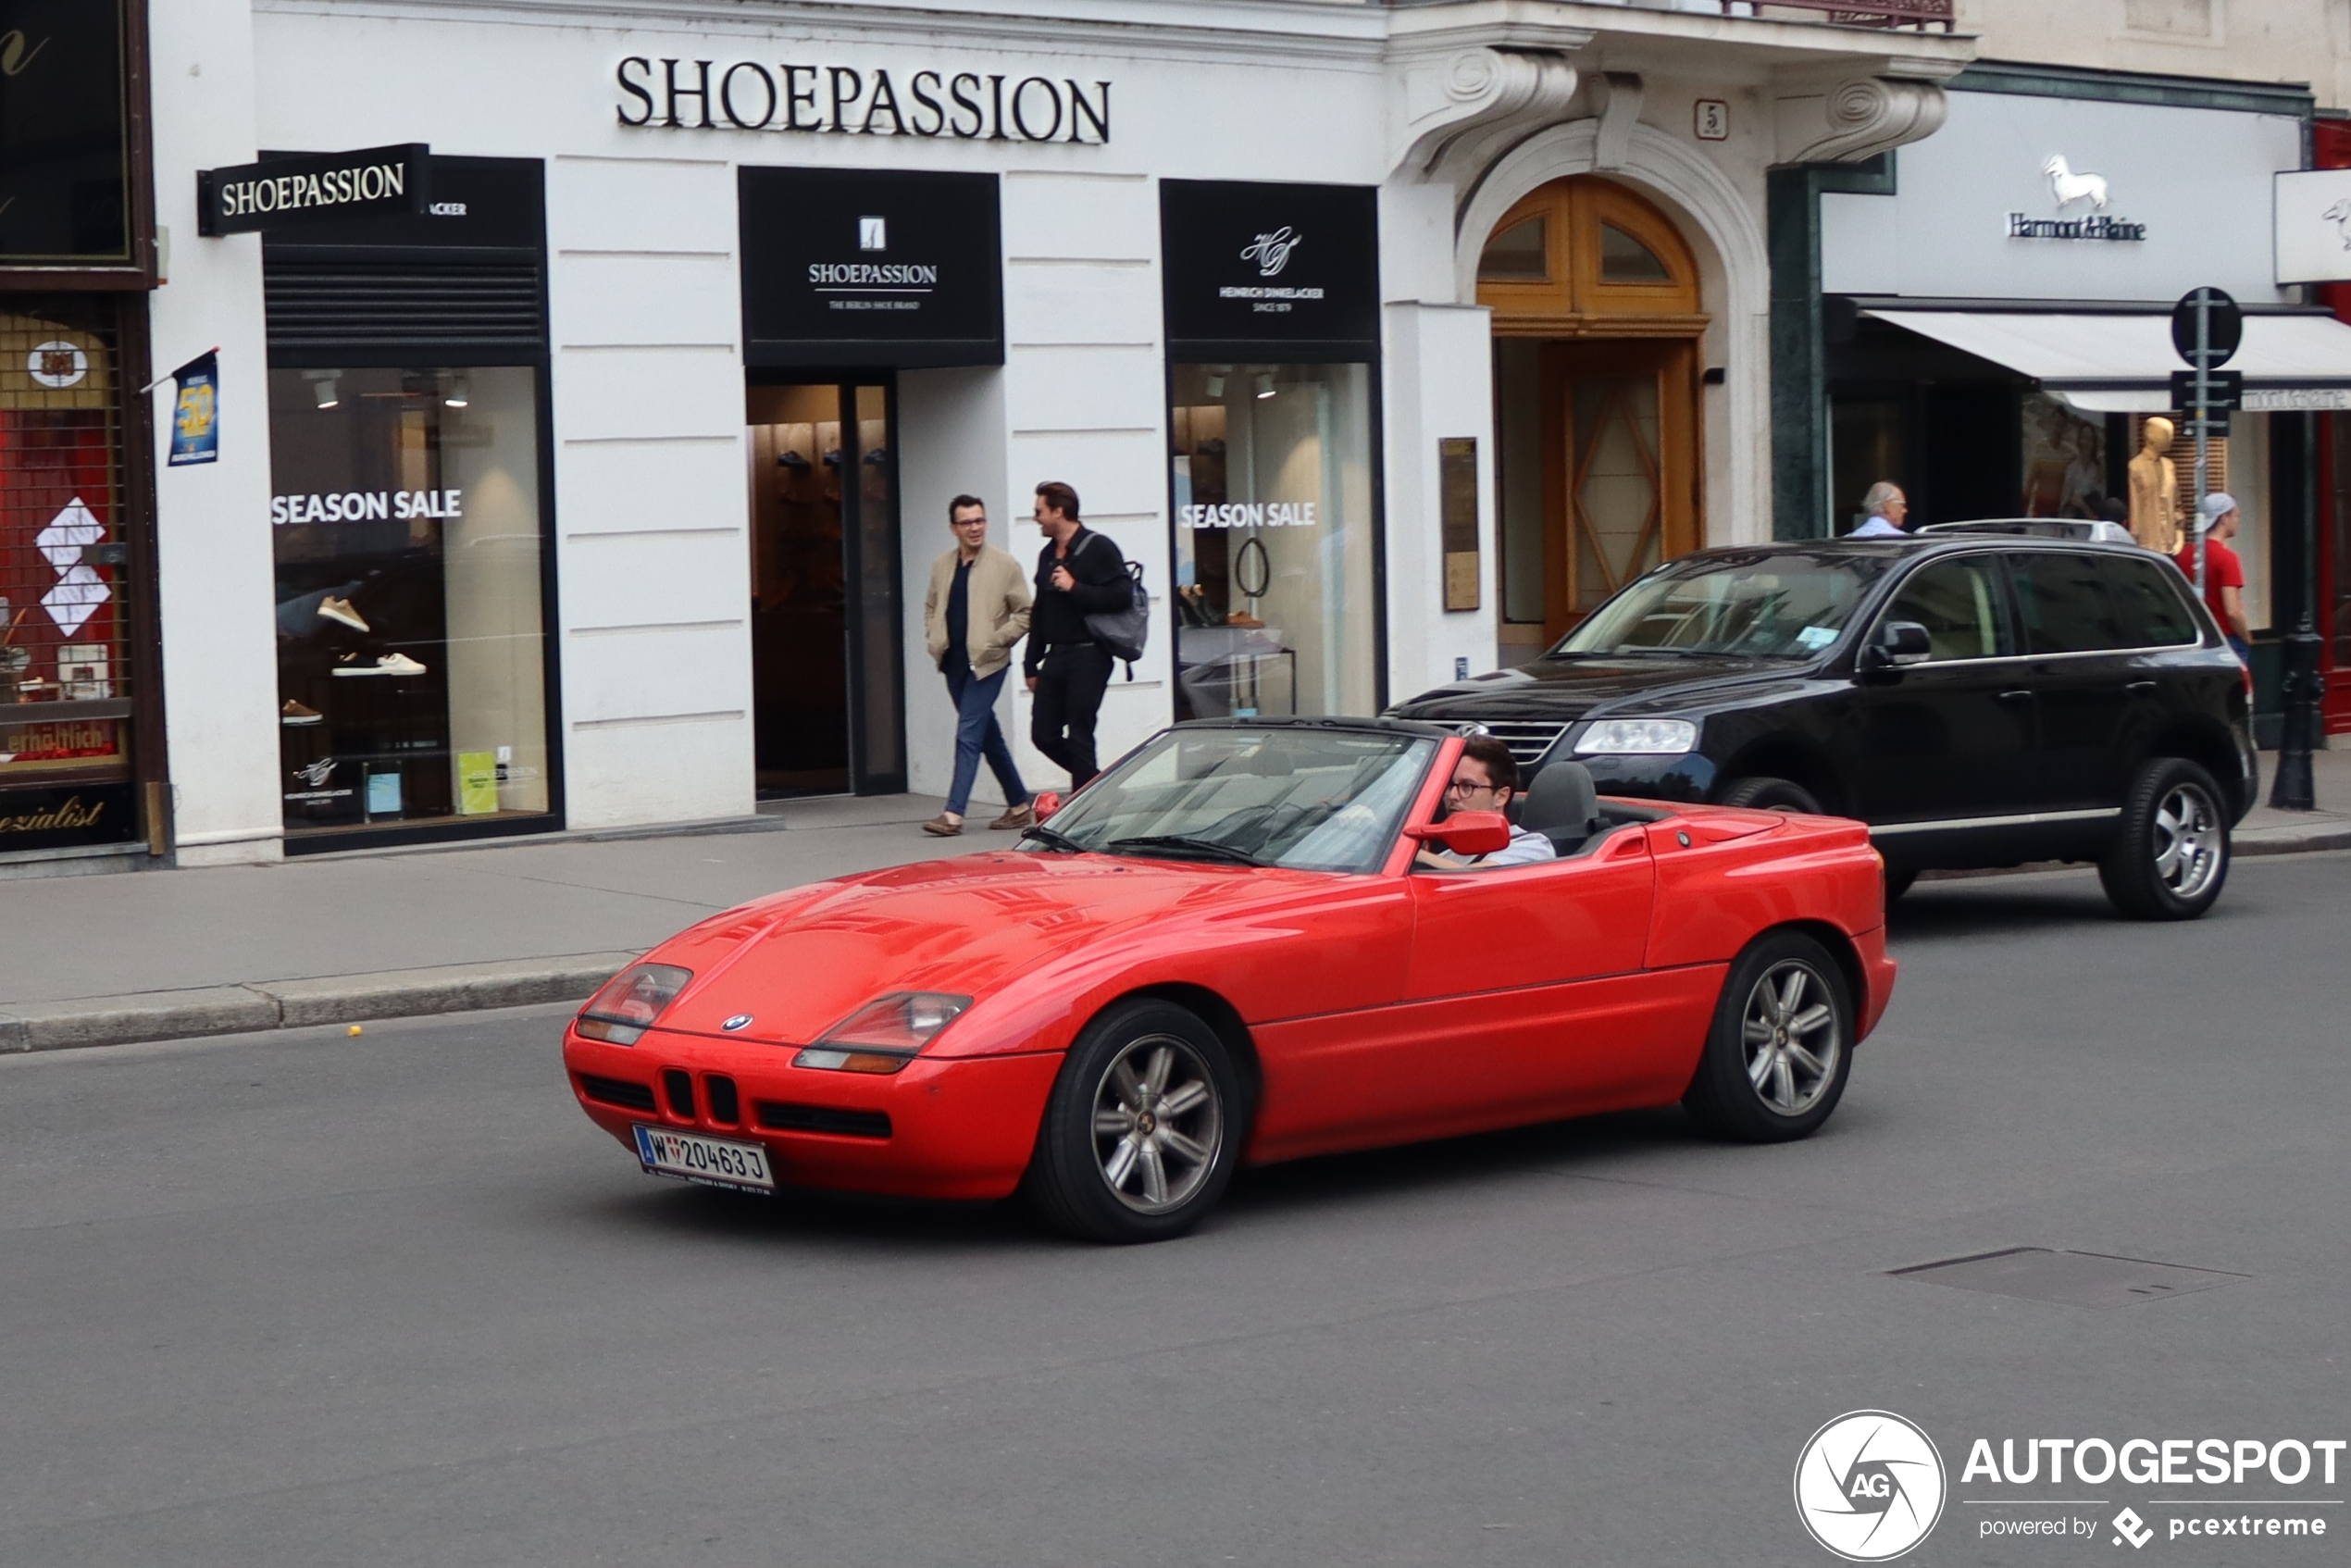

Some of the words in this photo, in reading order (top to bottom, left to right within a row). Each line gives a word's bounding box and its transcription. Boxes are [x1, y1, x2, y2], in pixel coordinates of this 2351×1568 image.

[617, 56, 1112, 143] SHOEPASSION
[1707, 105, 1718, 129] 5
[221, 163, 404, 216] SHOEPASSION
[808, 264, 938, 283] SHOEPASSION
[828, 301, 844, 309] THE
[1219, 287, 1263, 298] HEINRICH
[271, 492, 389, 524] SEASON
[394, 489, 462, 518] SALE
[1180, 504, 1264, 529] SEASON
[1267, 502, 1316, 527] SALE
[7, 724, 104, 753] erhältlich
[649, 1134, 667, 1163] W
